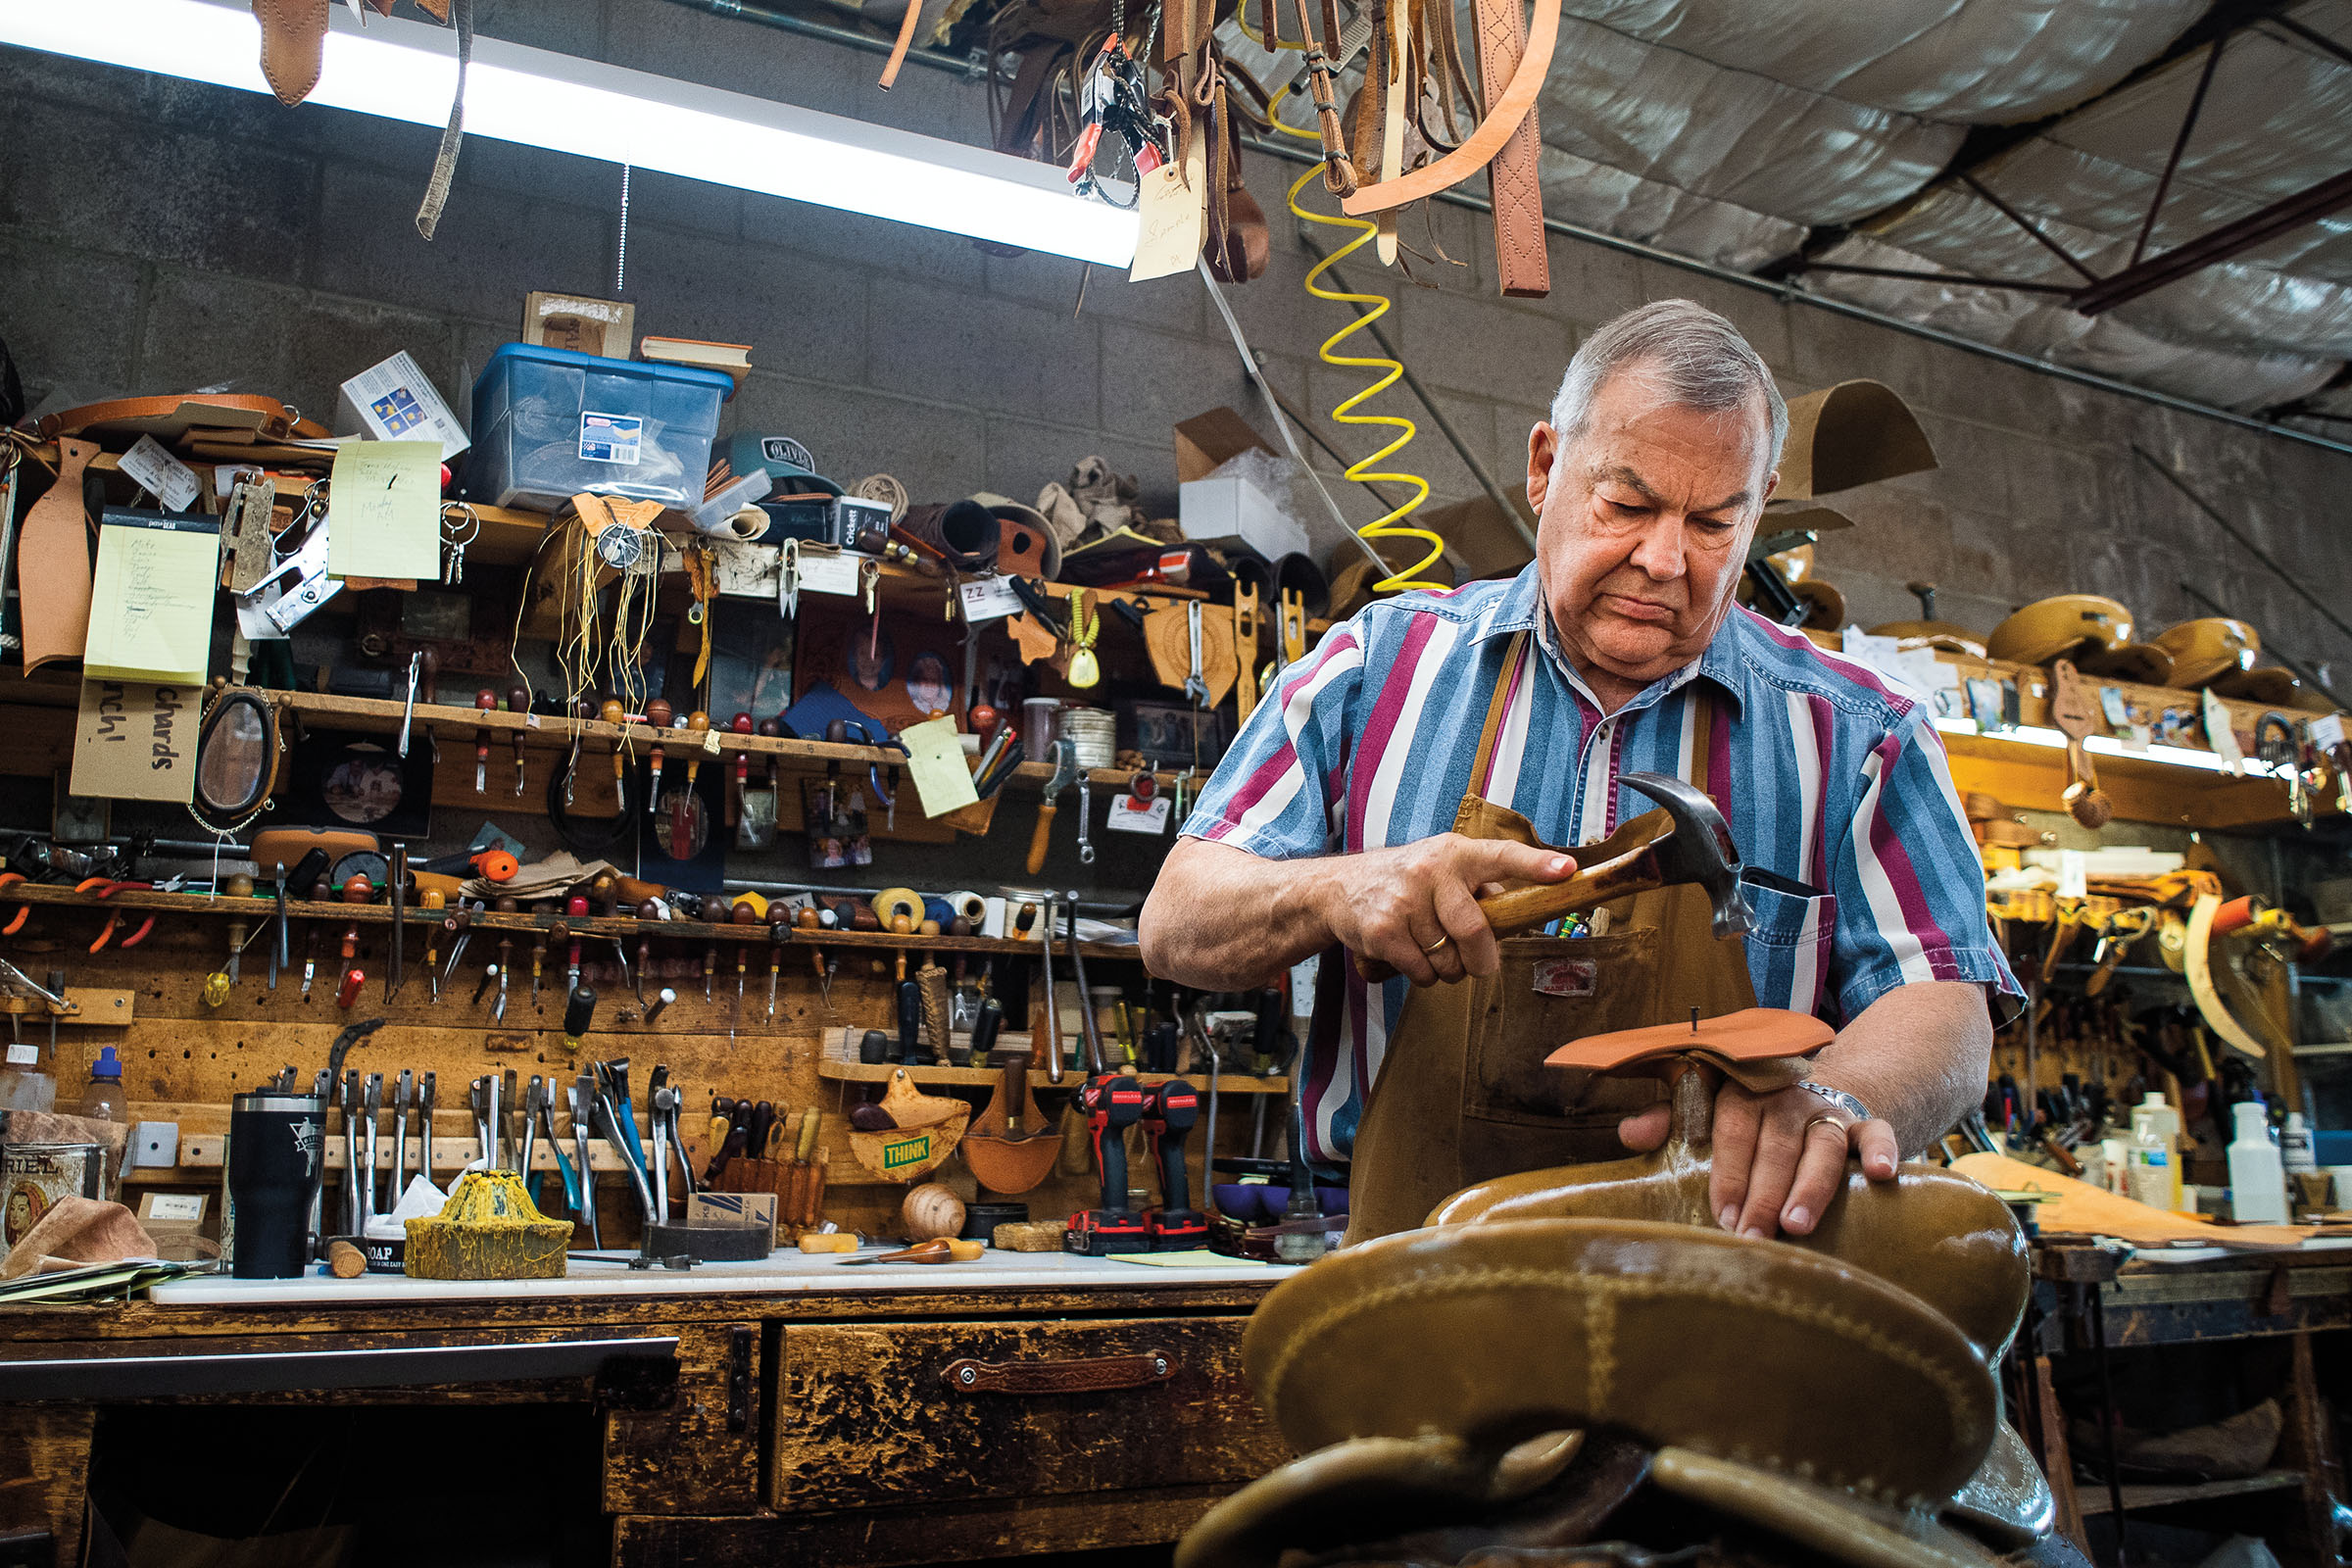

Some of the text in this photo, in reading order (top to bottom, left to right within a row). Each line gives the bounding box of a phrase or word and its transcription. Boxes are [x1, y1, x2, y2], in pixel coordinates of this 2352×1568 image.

[846, 509, 858, 546] Crickett
[886, 1139, 927, 1164] THINK
[0, 1158, 59, 1175] RIEL
[368, 1246, 393, 1261] SOAP
